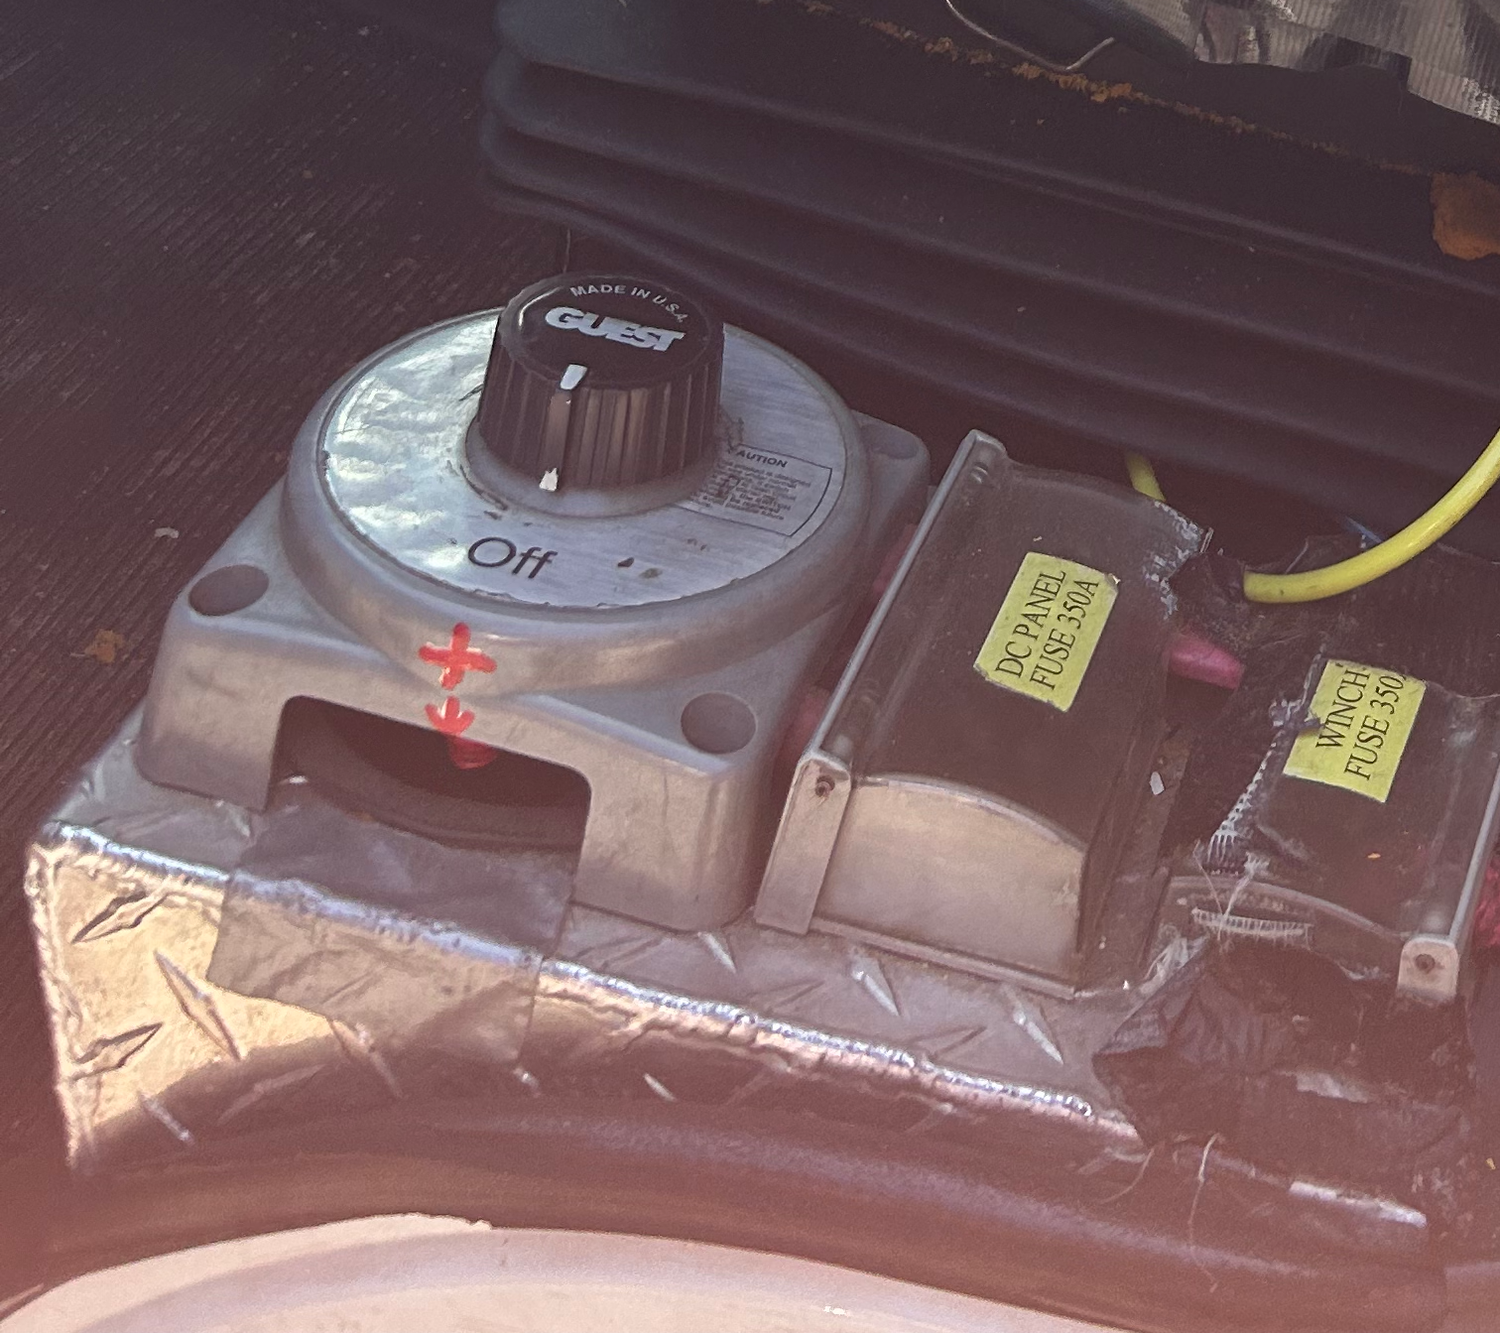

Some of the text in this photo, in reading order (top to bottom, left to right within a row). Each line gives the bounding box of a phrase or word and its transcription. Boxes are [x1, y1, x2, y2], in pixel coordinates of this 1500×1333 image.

[569, 283, 626, 298] MADE
[630, 286, 651, 300] IN
[544, 306, 687, 352] GUEST
[734, 449, 789, 469] AUTION
[467, 536, 559, 580] Off
[994, 570, 1067, 679] DC PANEL
[1029, 579, 1100, 691] FUSE 350A
[1315, 669, 1371, 748] WINCH
[1343, 673, 1407, 781] FUSE 350
